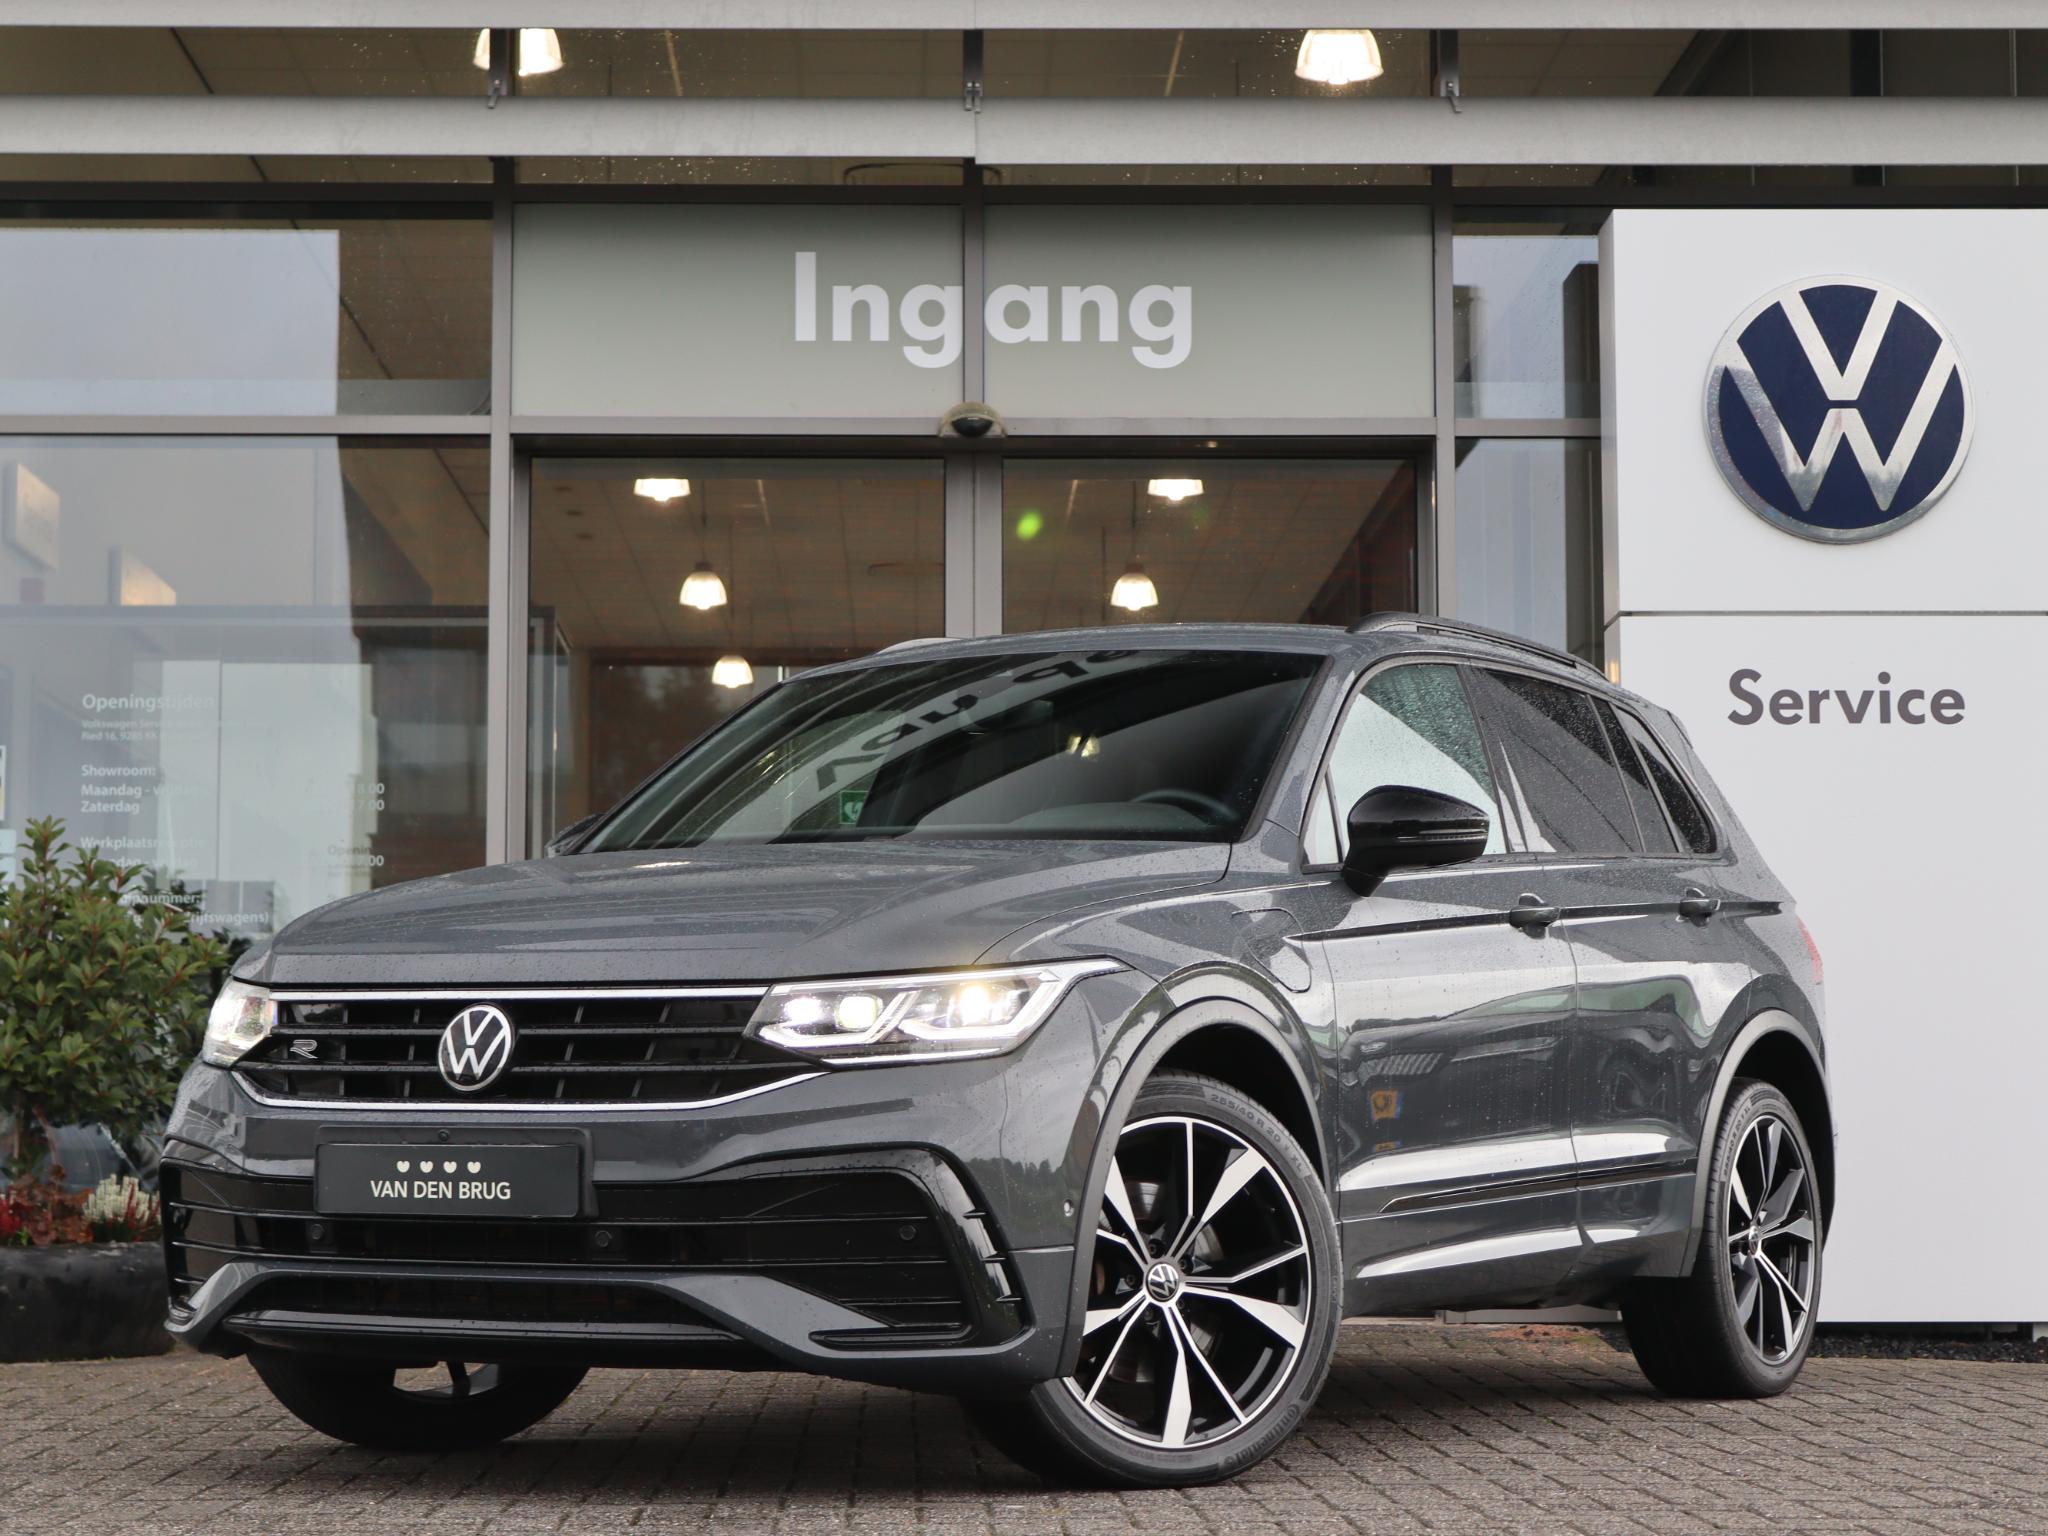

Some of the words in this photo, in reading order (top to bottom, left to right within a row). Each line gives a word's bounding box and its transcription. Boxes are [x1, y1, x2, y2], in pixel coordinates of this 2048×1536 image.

[795, 252, 1192, 368] Ingang
[1728, 669, 1965, 725] Service
[80, 763, 156, 777] Showroom:
[80, 784, 142, 798] Maandag
[80, 800, 140, 815] Zaterdag
[371, 1180, 408, 1198] VAN
[413, 1181, 453, 1199] DEN
[459, 1182, 511, 1200] BRUG
